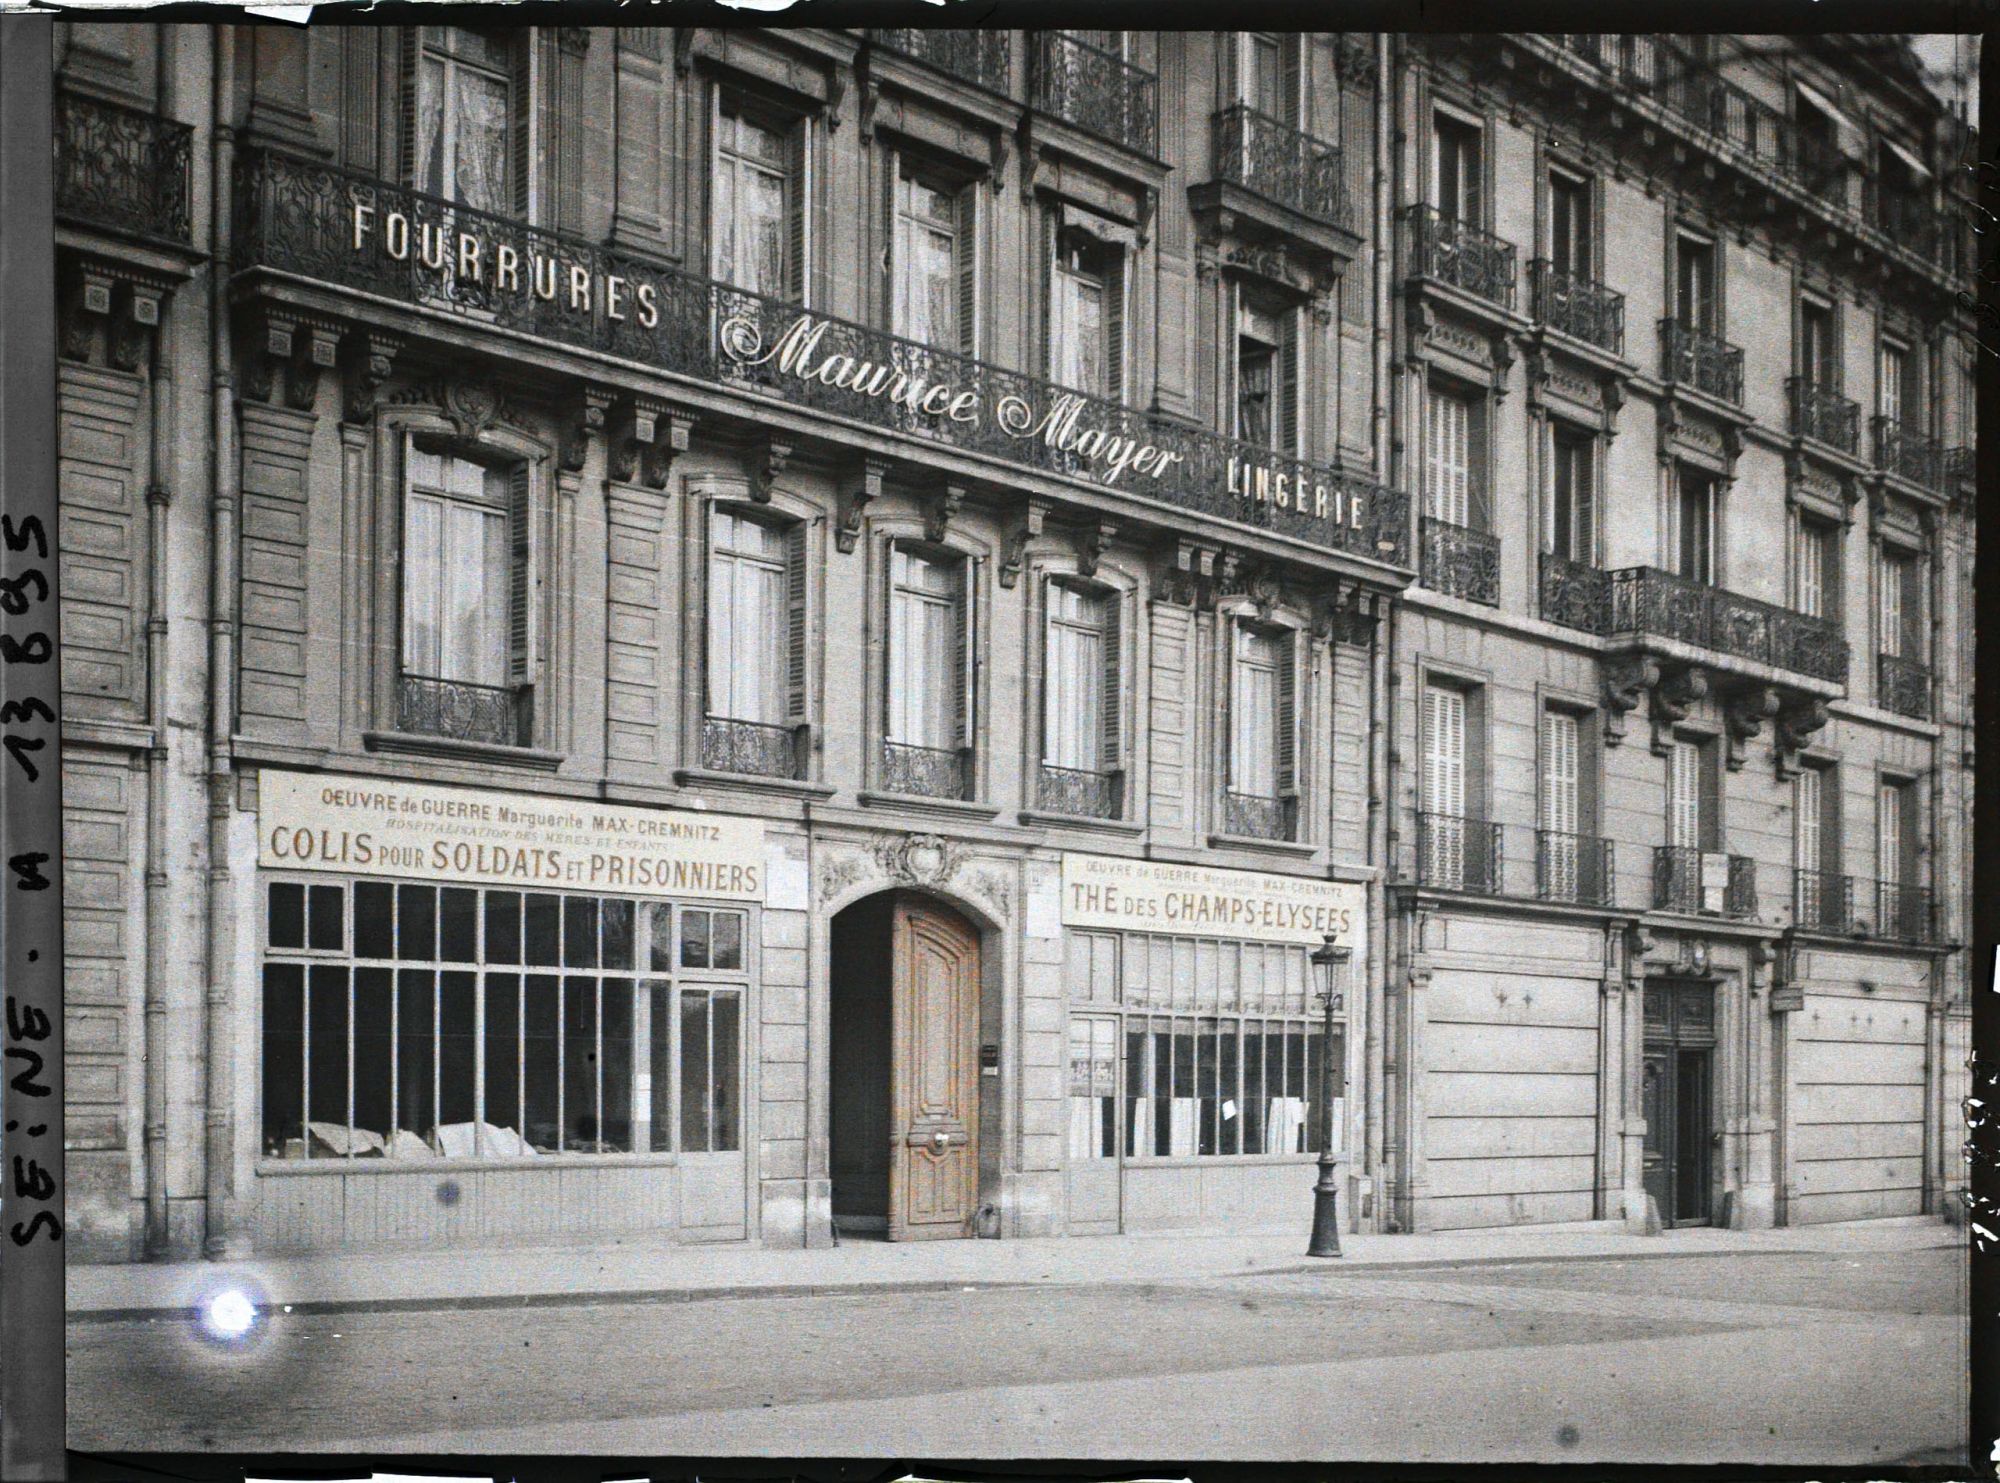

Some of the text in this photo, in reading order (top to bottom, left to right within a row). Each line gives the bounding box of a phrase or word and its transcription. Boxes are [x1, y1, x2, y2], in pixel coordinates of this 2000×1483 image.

[354, 204, 659, 330] FOURRURES
[721, 313, 1184, 485] Maurice Mayer
[1227, 457, 1363, 530] LINGERIE
[401, 796, 417, 813] de
[421, 799, 490, 821] GUERRE
[498, 807, 583, 829] Marguerite
[592, 815, 721, 842] MAX-CREMNITZ
[271, 826, 757, 893] COLIS POUR SOLDATS ET PRISONNIERS
[1154, 868, 1198, 882] GUERRE
[1071, 882, 1118, 914] THÉ
[1124, 896, 1157, 917] DES
